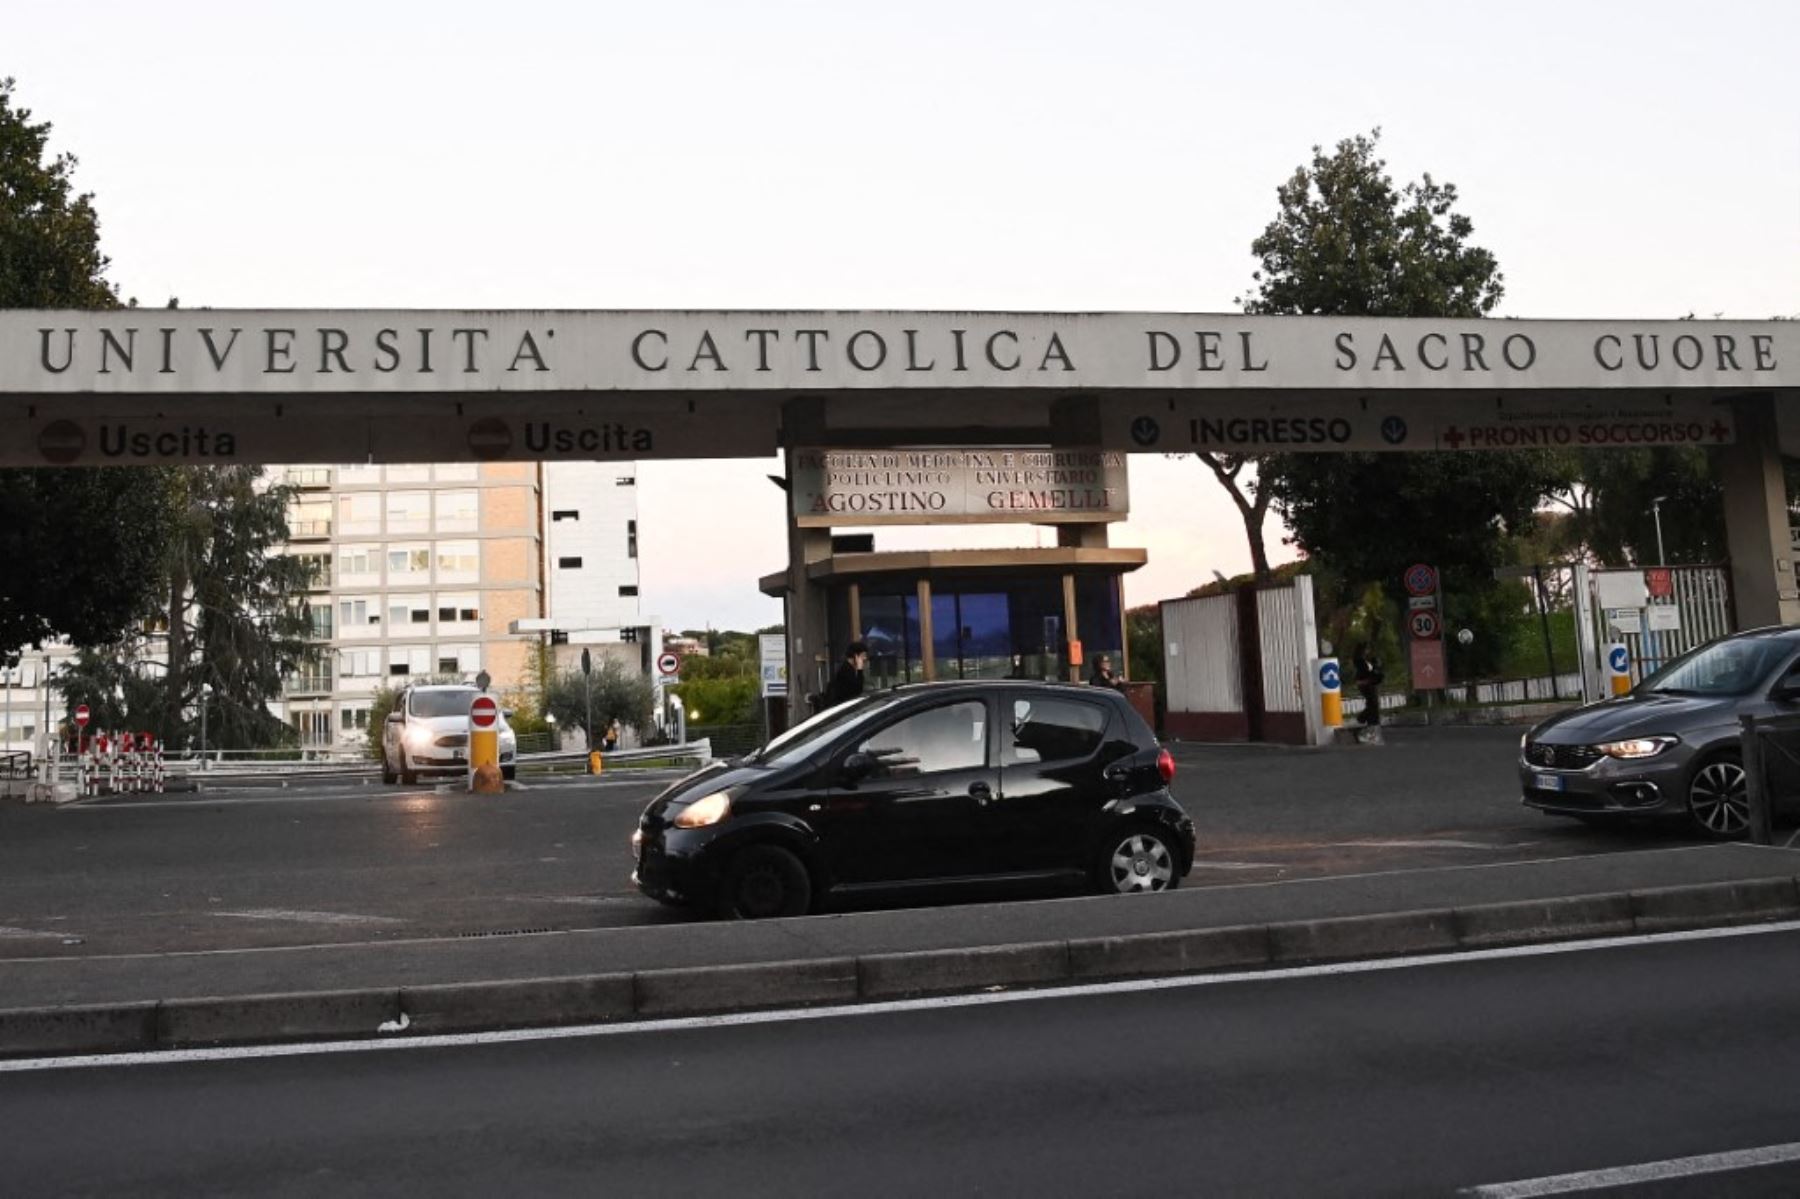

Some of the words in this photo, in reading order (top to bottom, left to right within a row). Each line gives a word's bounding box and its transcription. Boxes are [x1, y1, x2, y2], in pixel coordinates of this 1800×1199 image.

[631, 329, 1076, 373] CATTOLICA
[1145, 331, 1268, 372] DEL
[1335, 333, 1537, 372] SACRO
[1594, 334, 1777, 372] CUORE
[99, 425, 235, 457] Uscita
[525, 422, 652, 453] Uscita
[1189, 417, 1353, 445] INGRESSO
[1470, 424, 1571, 447] PRONTO
[1577, 423, 1704, 445] SOCCORSO
[906, 453, 995, 469] MEDICINA
[1003, 453, 1014, 468] E
[1021, 452, 1123, 468] CHIRURGIA
[827, 470, 951, 486] POLICLINICO
[976, 469, 1098, 485] UNIVERSITARIO
[1415, 617, 1432, 632] 30
